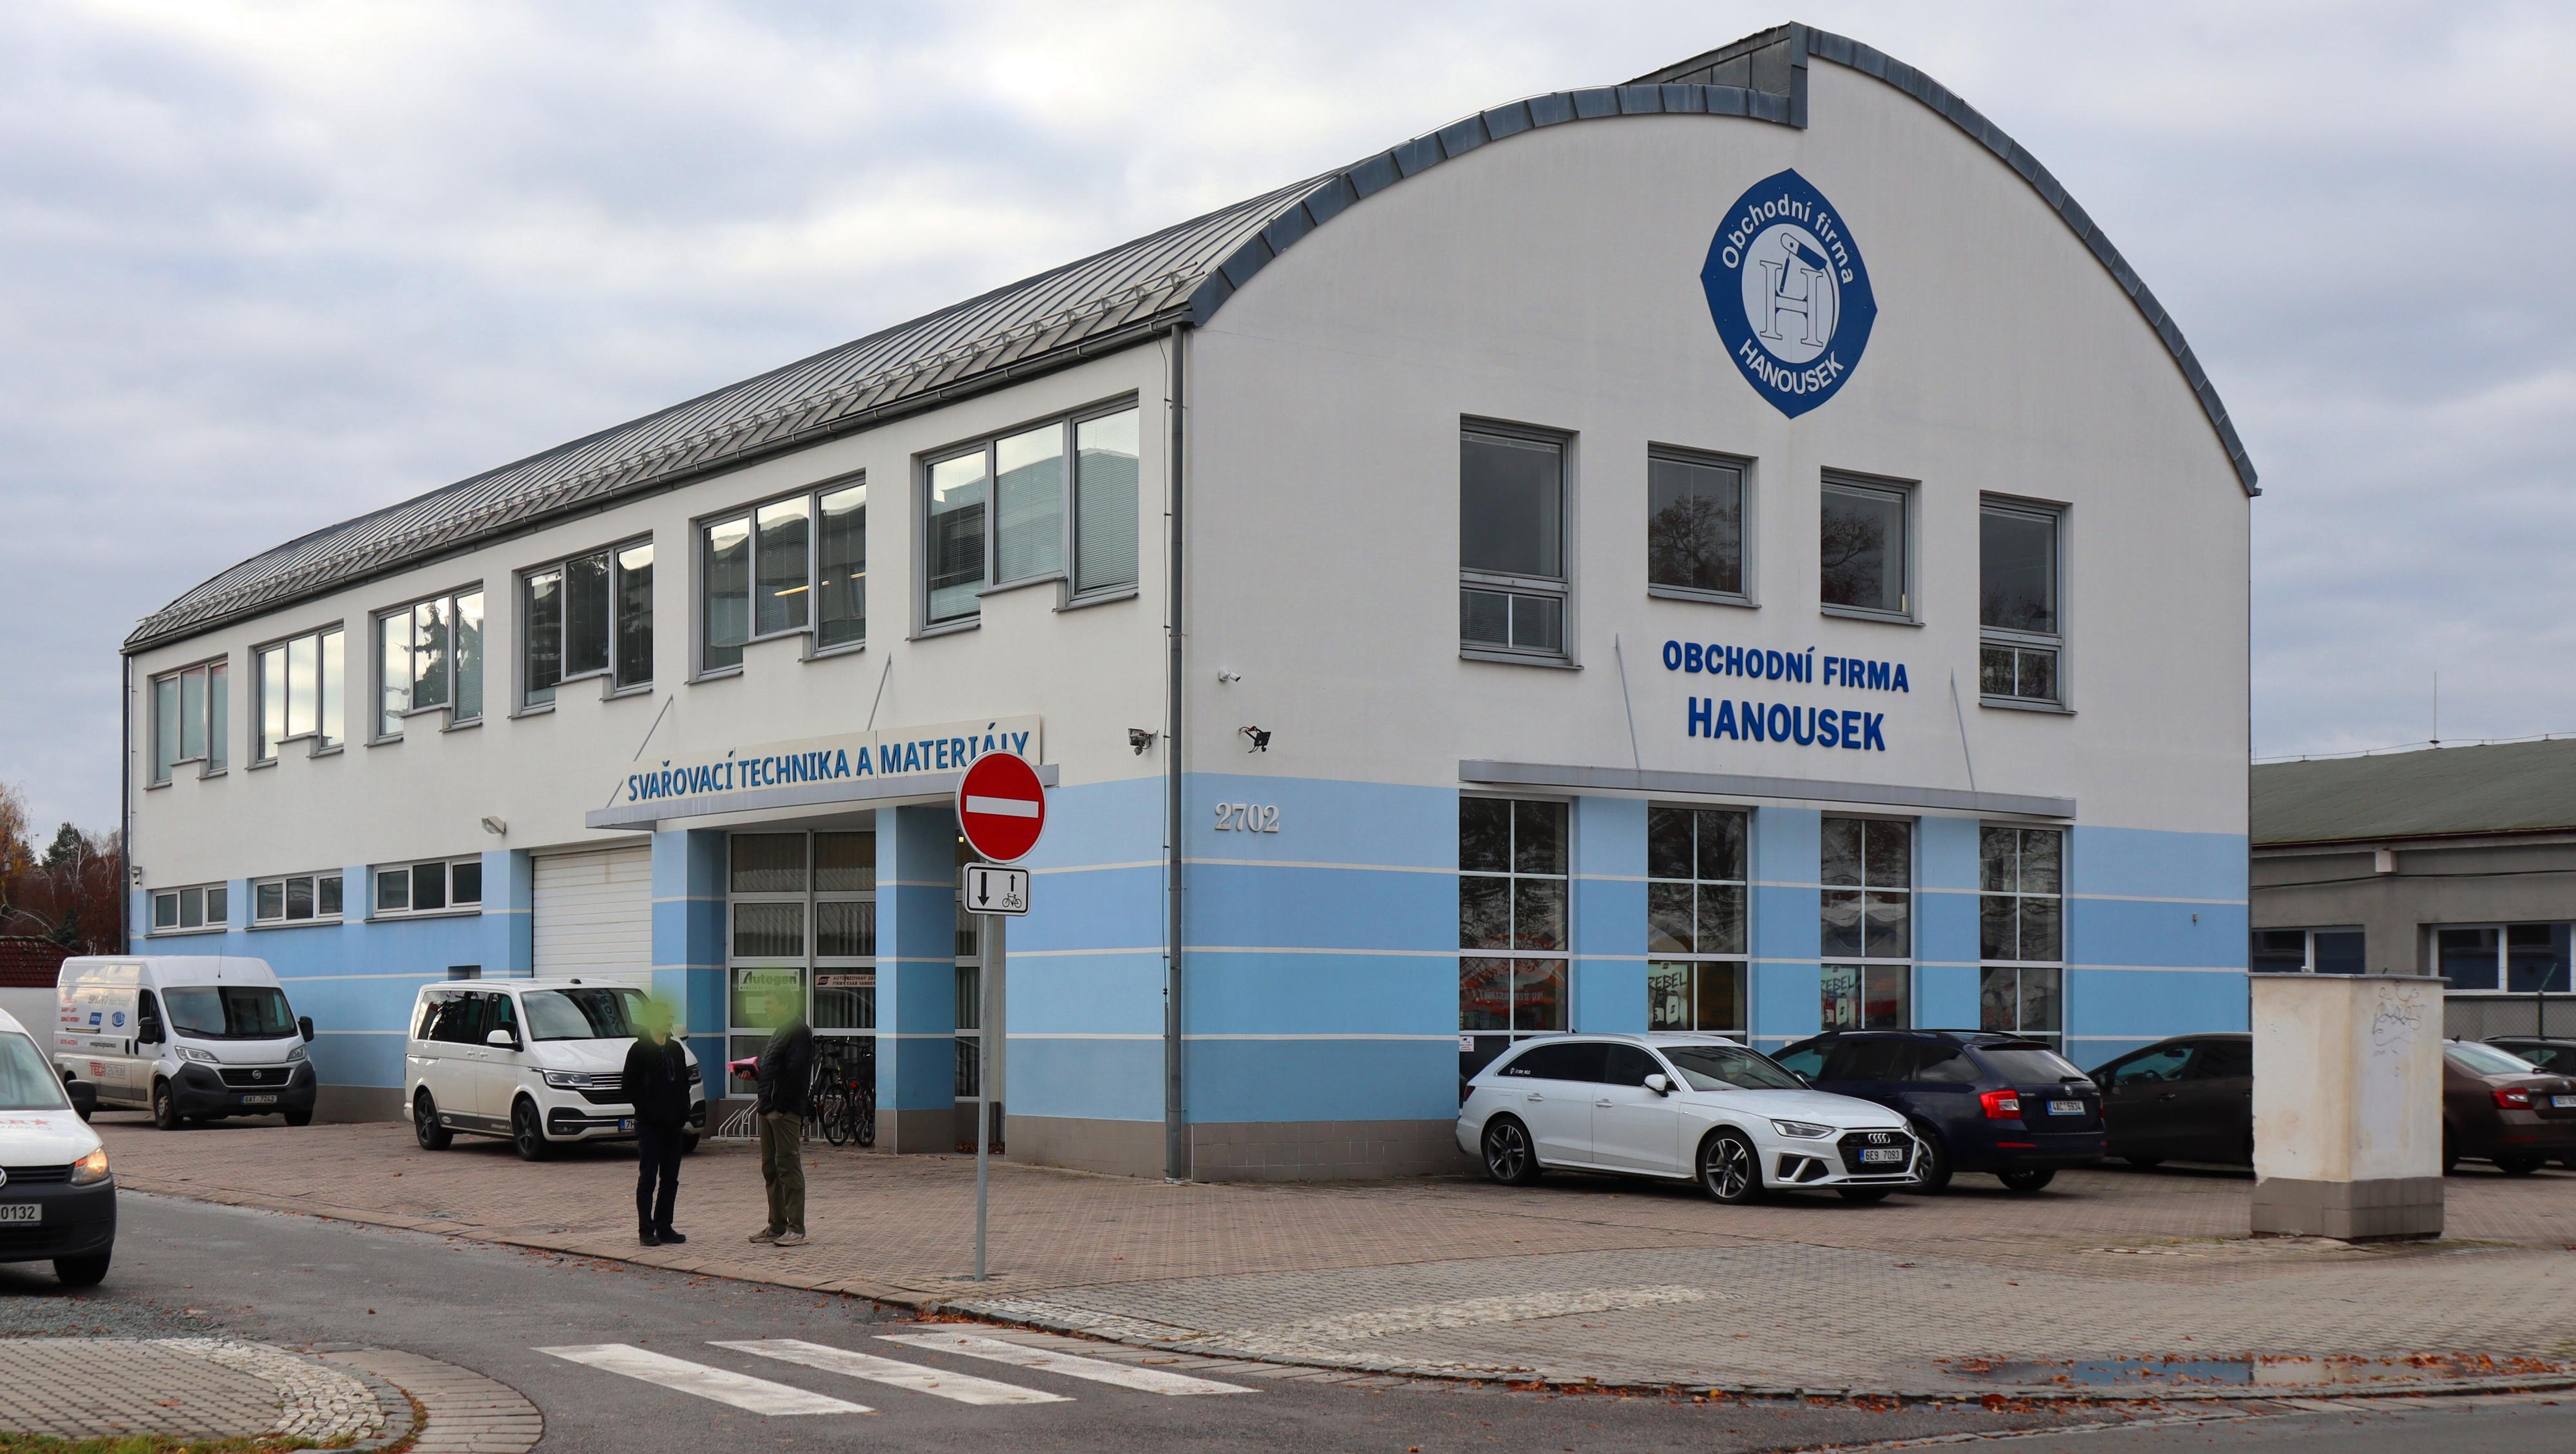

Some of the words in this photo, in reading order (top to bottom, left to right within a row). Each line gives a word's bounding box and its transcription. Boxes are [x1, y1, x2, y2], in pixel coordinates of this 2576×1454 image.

[1722, 194, 1813, 269] Obchodní
[1817, 212, 1853, 284] firma
[1739, 338, 1844, 394] HANOUSEK
[1663, 640, 1815, 684] OBCHODNÍ
[1823, 656, 1909, 693] FIRMA
[1688, 696, 1886, 752] HANOUSEK
[628, 750, 734, 801] SVAŘOVACÍ
[738, 749, 851, 787] TECHNIKA
[856, 746, 873, 776] A
[1215, 803, 1279, 832] 2702
[743, 971, 797, 986] Autogen
[1865, 1151, 1879, 1160] 6E9
[1883, 1150, 1899, 1160] 7093
[1, 1206, 35, 1220] 0132
